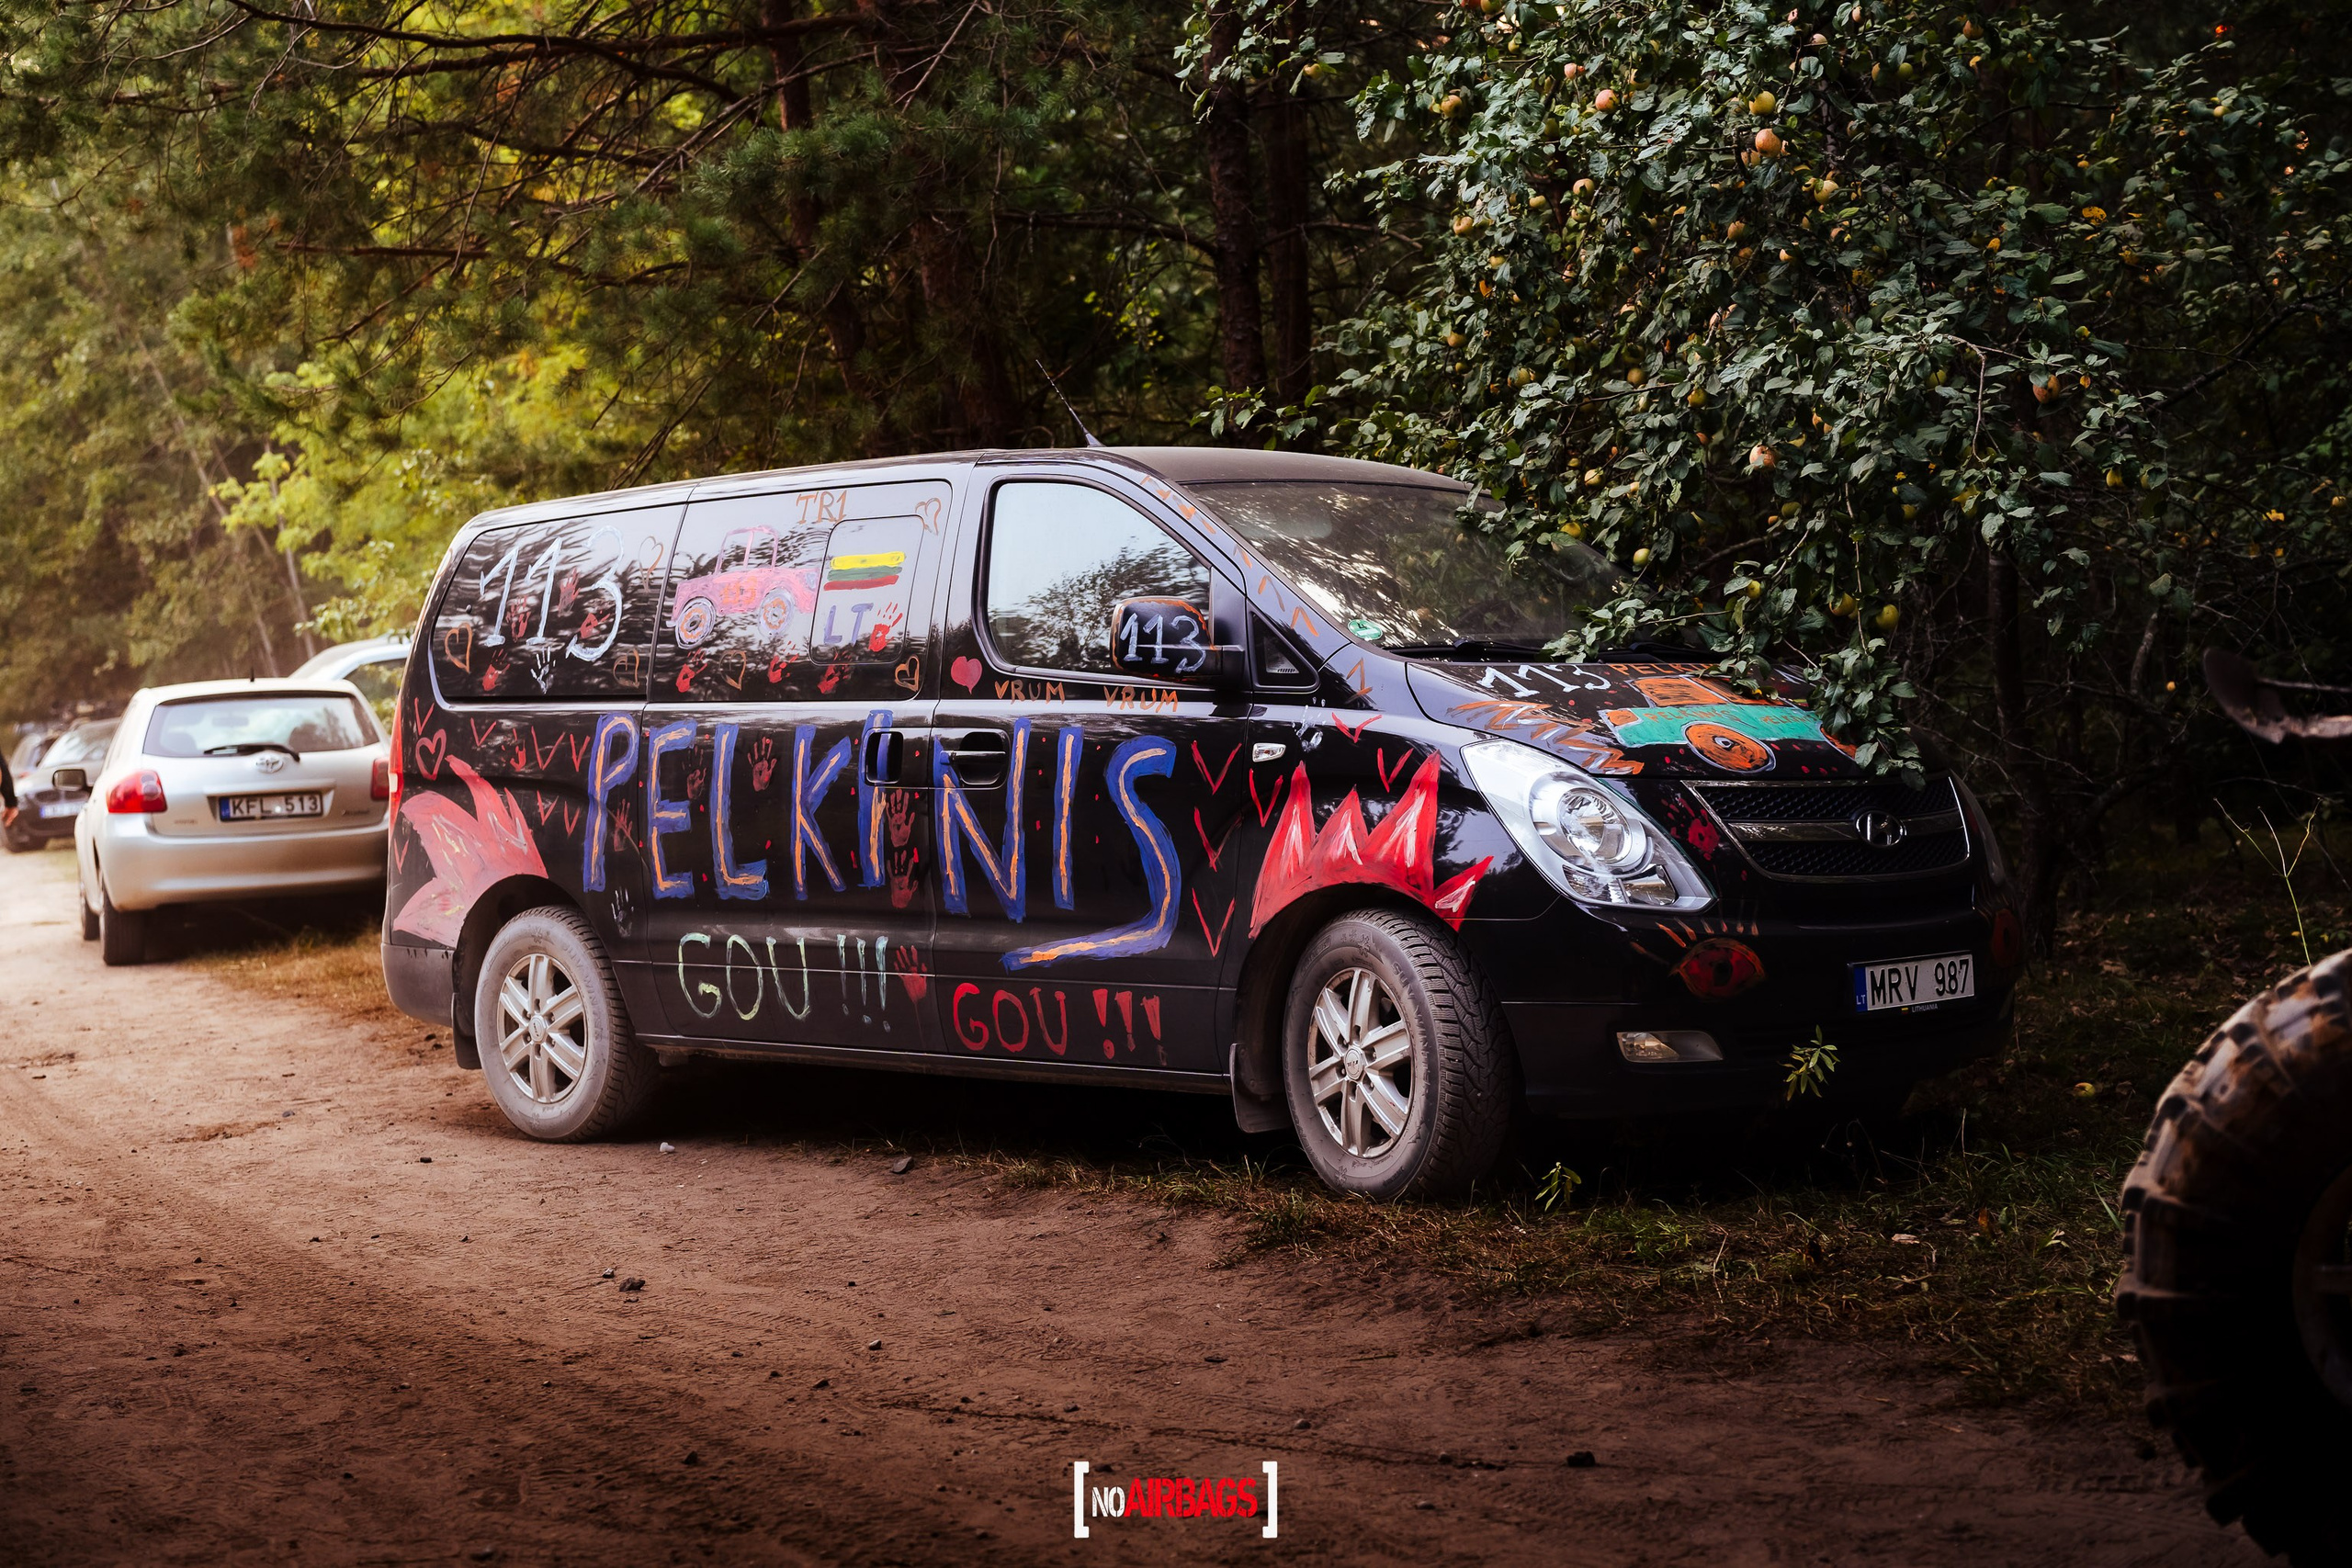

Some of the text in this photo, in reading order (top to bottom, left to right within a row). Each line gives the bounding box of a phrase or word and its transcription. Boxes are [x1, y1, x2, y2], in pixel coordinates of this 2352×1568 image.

[480, 525, 624, 661] 113
[824, 603, 874, 647] LT
[1120, 613, 1206, 674] 113
[1476, 664, 1611, 698] 113
[1606, 662, 1715, 675] PELKI
[994, 679, 1179, 713] VRUM VRUM
[232, 795, 319, 815] KFL 513
[582, 709, 1182, 971] PELKINIS
[678, 932, 811, 1021] GOU
[1391, 962, 1416, 1000] SUV
[1870, 959, 1970, 1006] MRV 987
[953, 982, 1068, 1055] GOU
[1856, 995, 1866, 1005] LT
[1911, 1003, 1939, 1012] LITHUANIA
